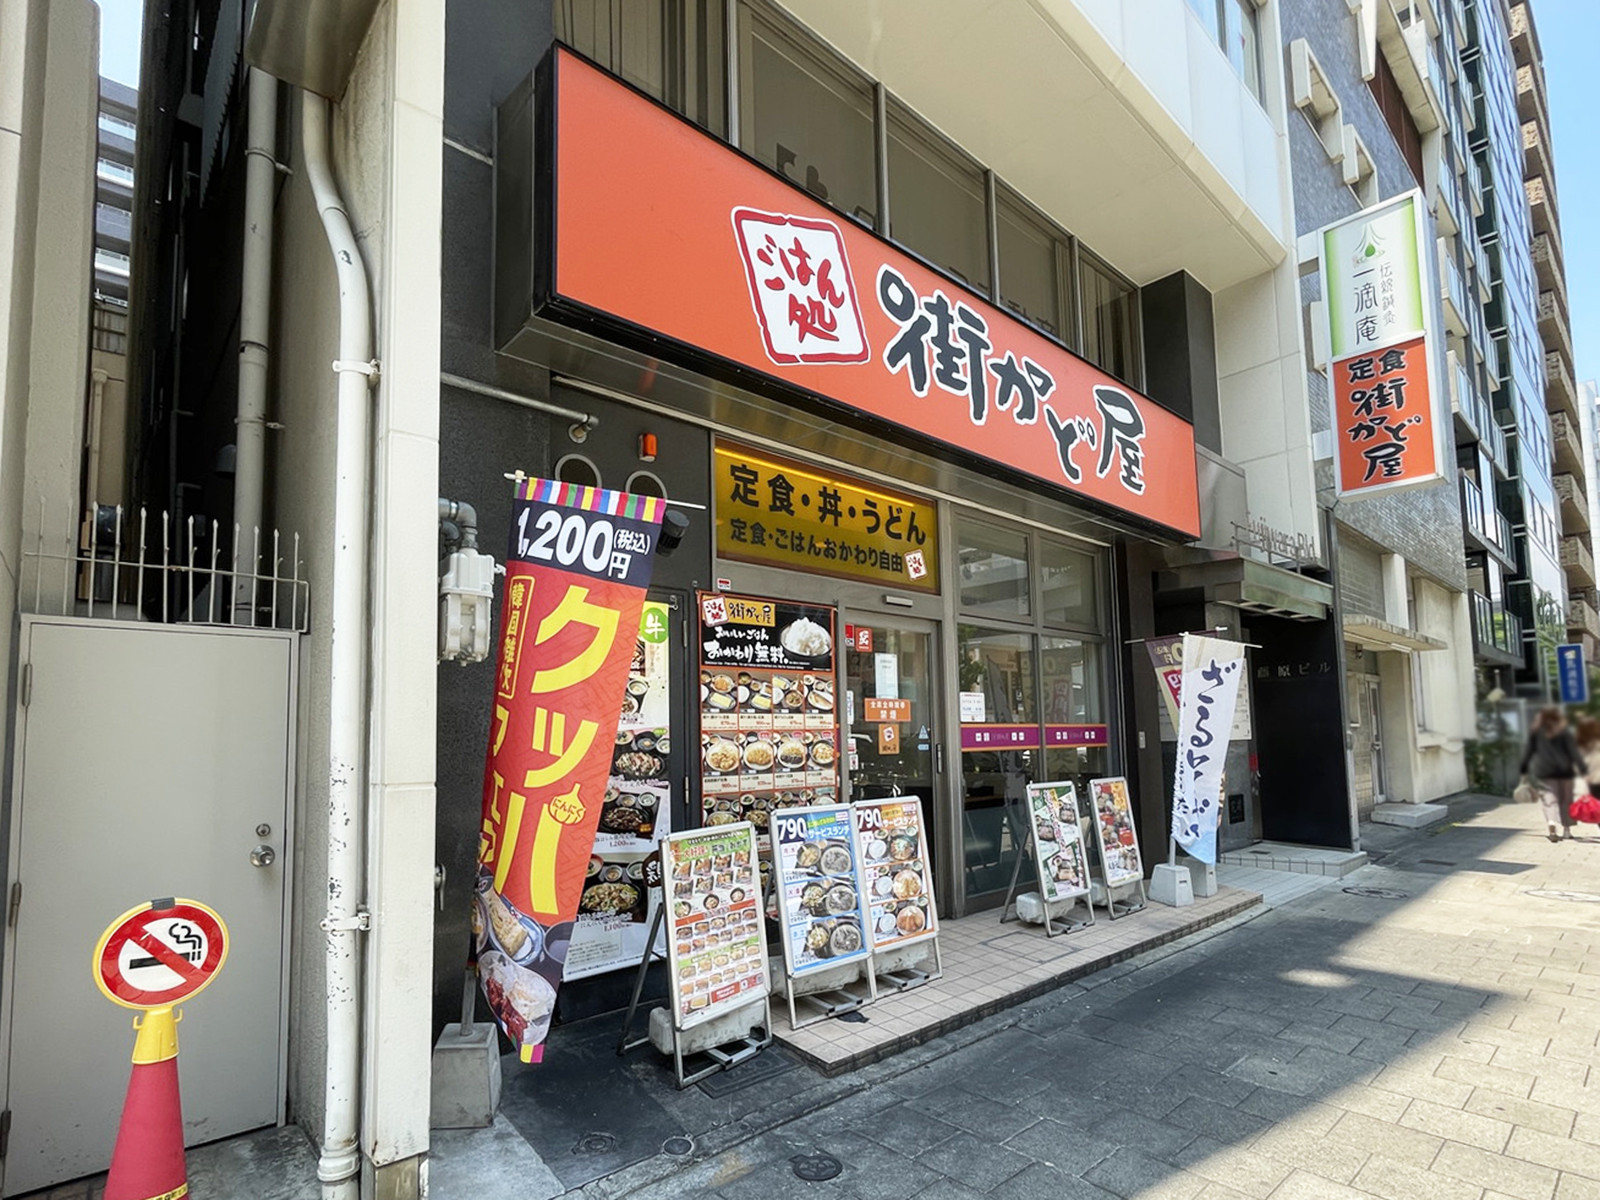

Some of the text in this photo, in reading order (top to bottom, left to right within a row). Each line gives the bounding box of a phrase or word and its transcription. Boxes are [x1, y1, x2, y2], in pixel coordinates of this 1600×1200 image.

[757, 234, 845, 309] ごはん
[1352, 267, 1380, 346] 一滴庵
[877, 267, 1145, 495] 街かど屋
[1348, 348, 1406, 384] 定食
[730, 464, 926, 545] 定食・丼・うどん
[613, 528, 651, 555] (税込)
[730, 518, 903, 574] 定食・ごはんおかわり自由
[644, 613, 666, 640] 牛
[552, 798, 585, 818] にんにく
[856, 808, 882, 829] 790
[777, 817, 807, 841] 790
